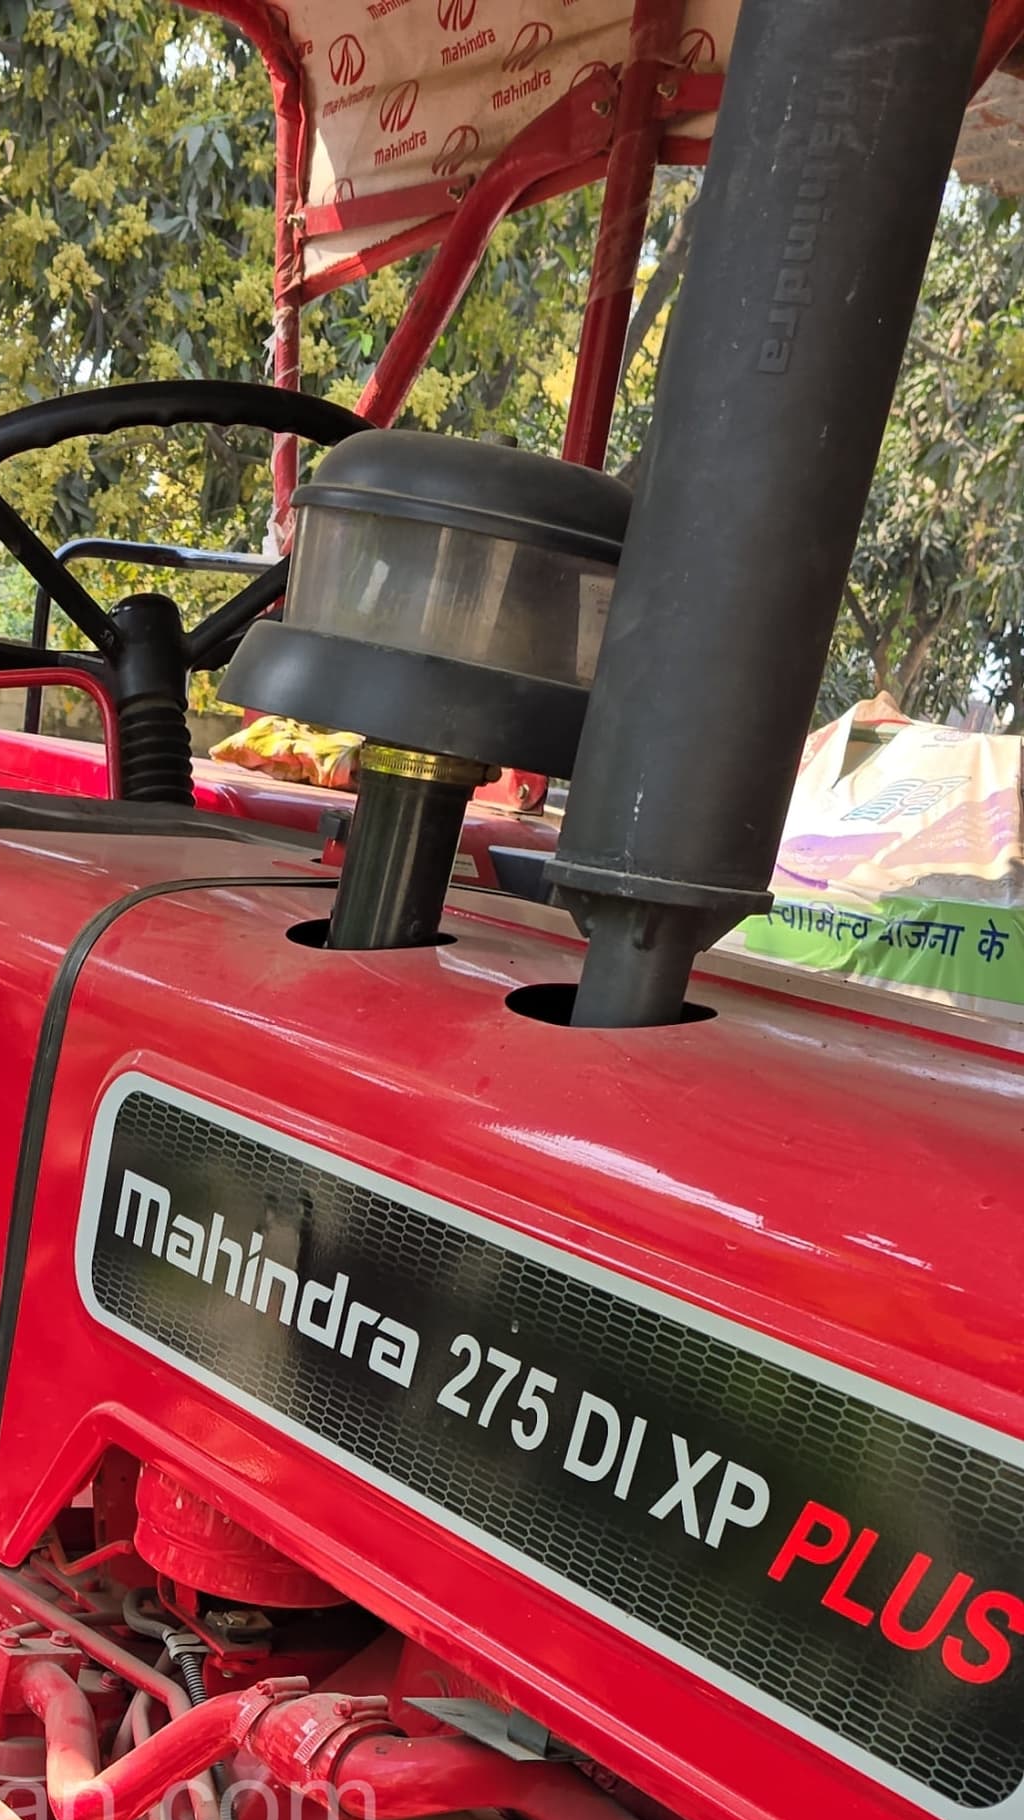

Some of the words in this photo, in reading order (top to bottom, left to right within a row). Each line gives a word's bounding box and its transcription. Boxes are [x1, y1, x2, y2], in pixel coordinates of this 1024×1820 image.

[977, 918, 1010, 963] के
[113, 1168, 421, 1389] Mahindra
[436, 1333, 558, 1452] 275
[562, 1390, 648, 1501] DI
[648, 1432, 771, 1550] XP
[767, 1500, 1024, 1684] PLUS
